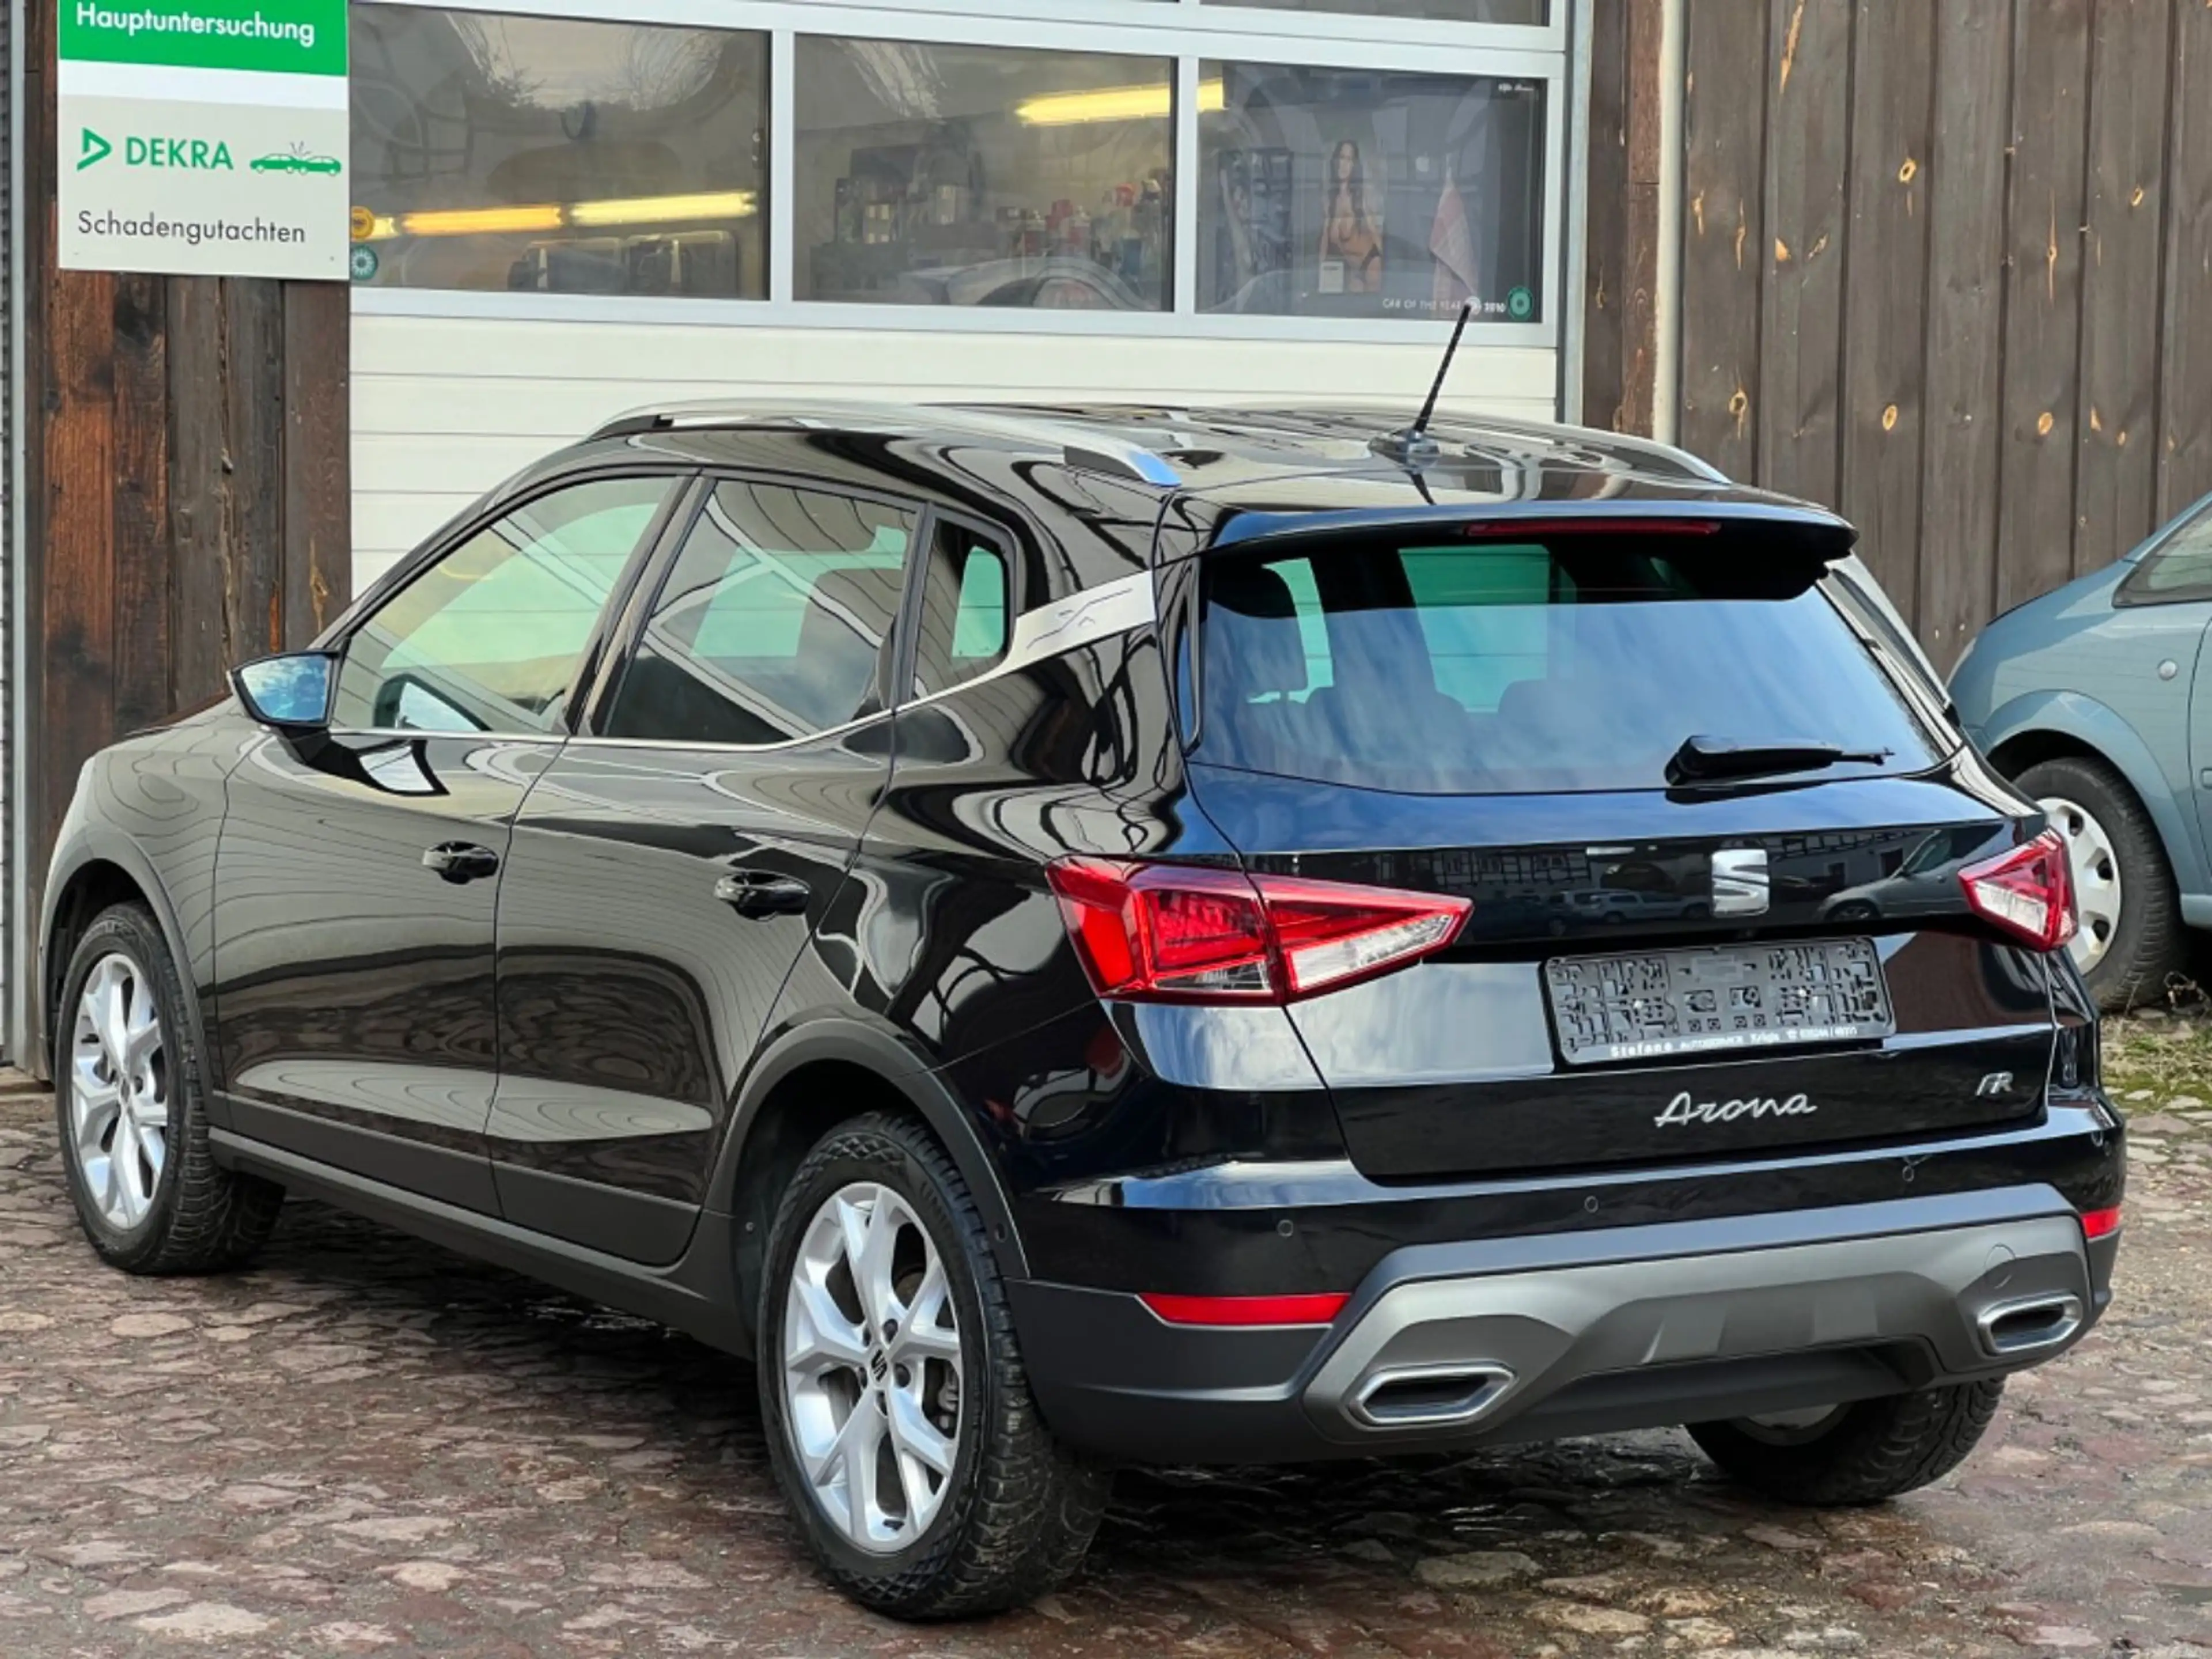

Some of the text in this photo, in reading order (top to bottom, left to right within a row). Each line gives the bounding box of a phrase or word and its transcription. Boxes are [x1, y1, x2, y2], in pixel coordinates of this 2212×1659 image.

[77, 2, 315, 47] Hauptuntersuchung
[126, 137, 234, 171] DEKRA
[78, 210, 305, 245] Schadengutachten
[1654, 1091, 1818, 1127] Arona
